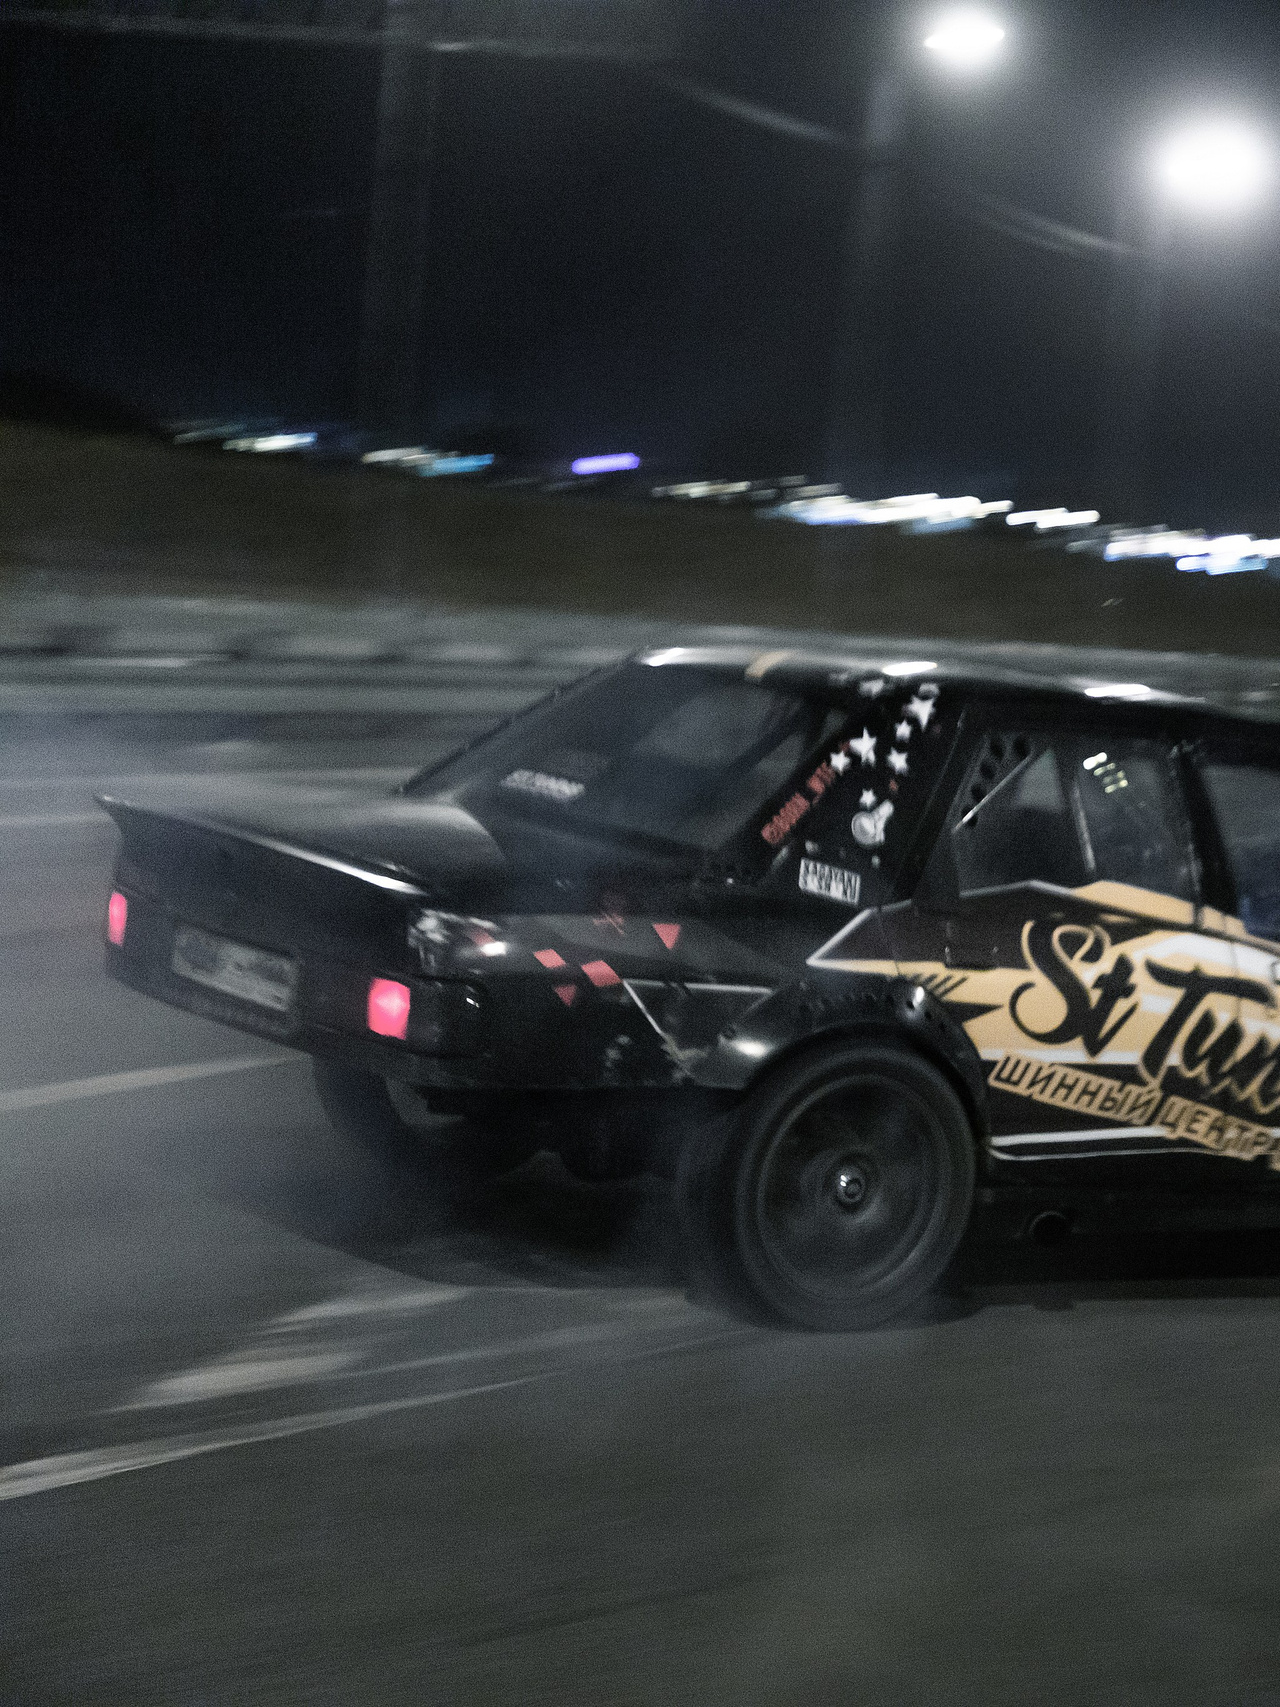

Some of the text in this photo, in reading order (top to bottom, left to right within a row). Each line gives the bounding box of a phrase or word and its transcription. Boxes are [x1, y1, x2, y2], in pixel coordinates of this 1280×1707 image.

[1008, 919, 1140, 1058] St
[992, 1055, 1161, 1124] ШИННЫЙ
[1161, 1098, 1273, 1159] ЦЕНТР
